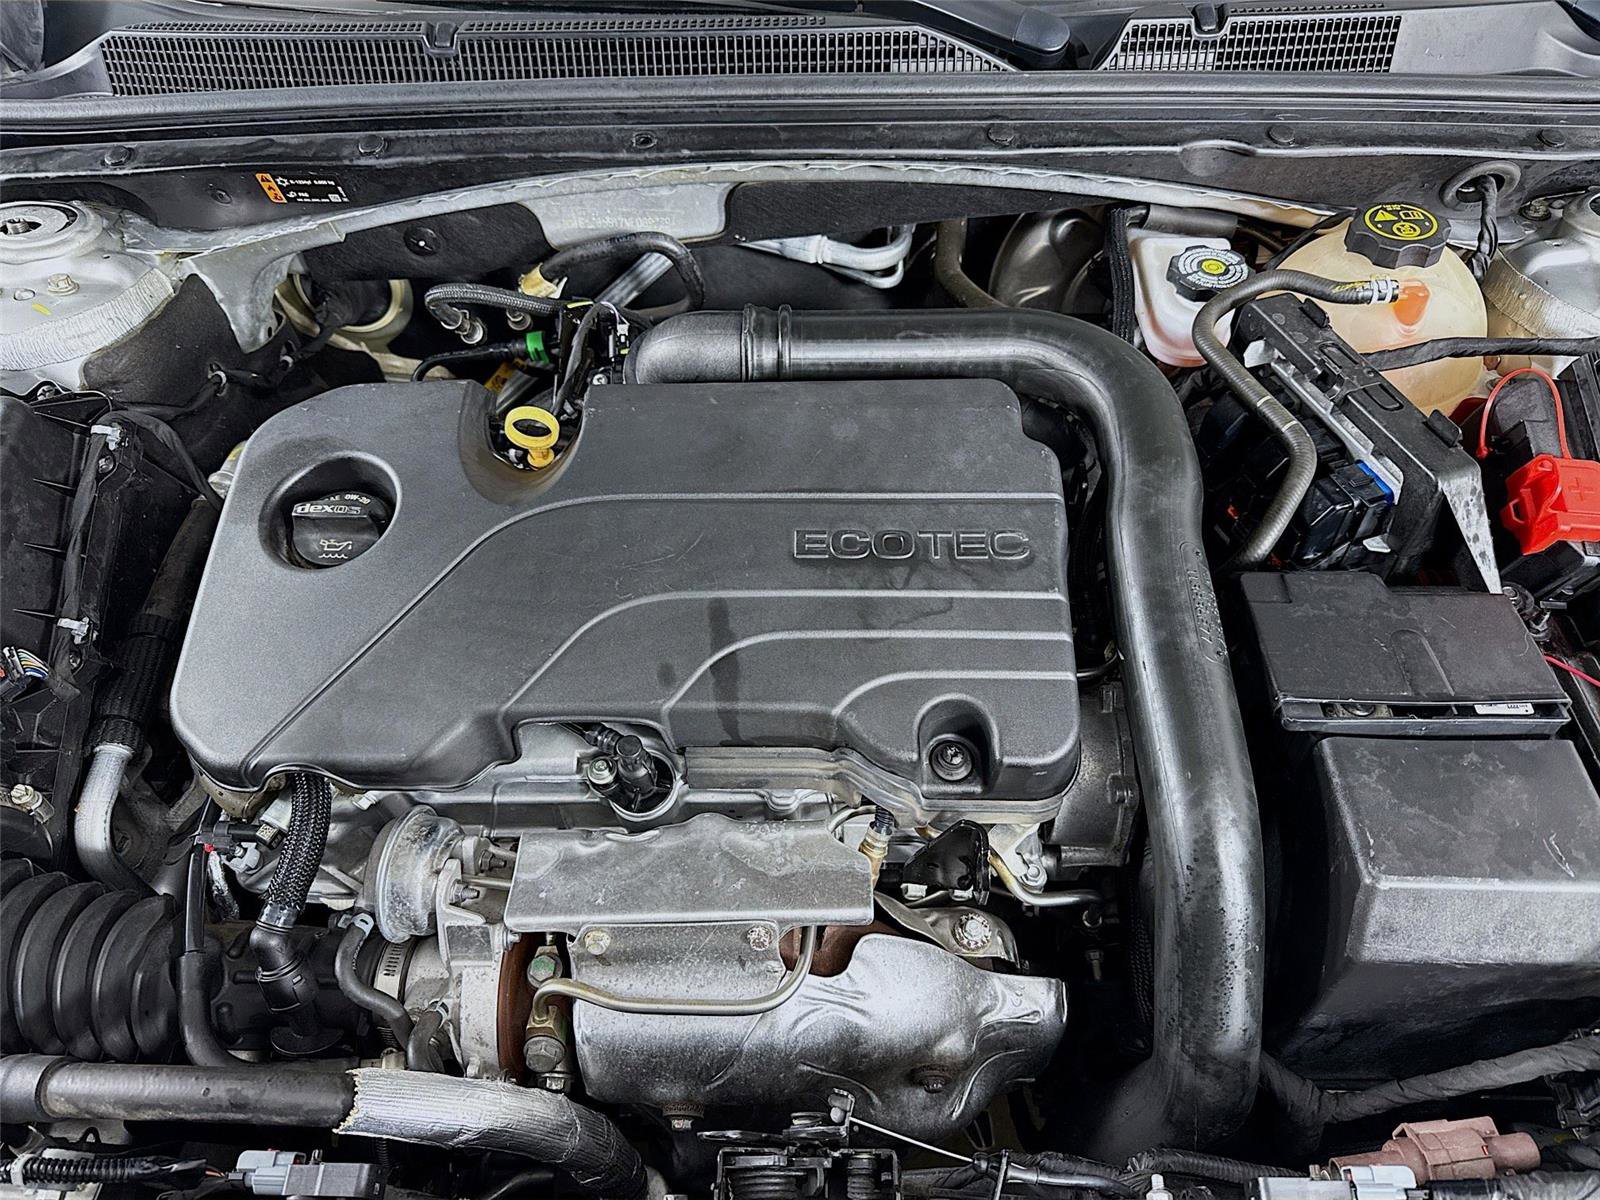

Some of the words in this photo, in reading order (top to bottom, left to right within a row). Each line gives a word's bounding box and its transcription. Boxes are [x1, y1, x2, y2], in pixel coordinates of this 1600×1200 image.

[344, 494, 371, 505] 0W-20
[297, 503, 361, 514] dexos
[793, 529, 1031, 560] ECOTEC
